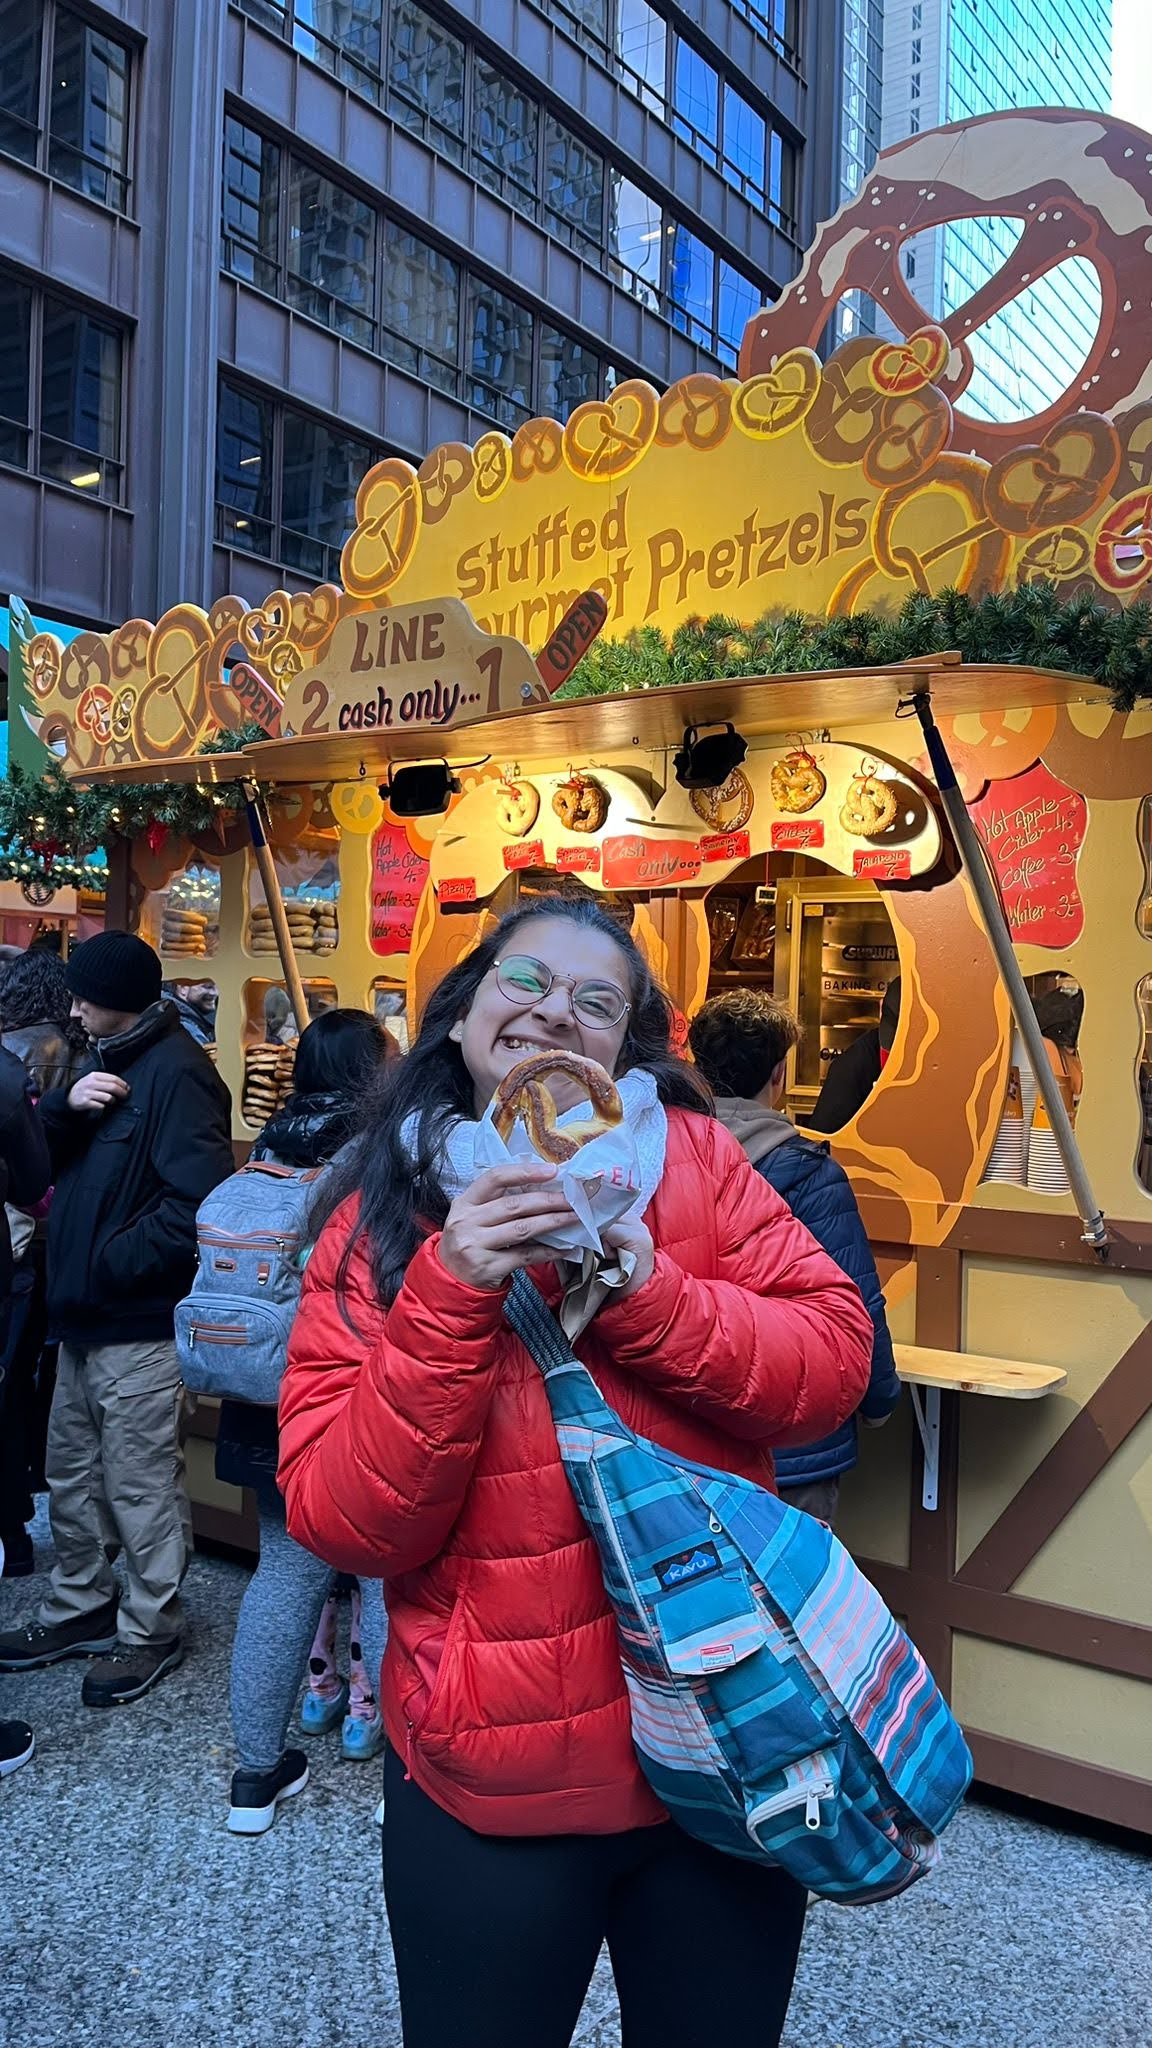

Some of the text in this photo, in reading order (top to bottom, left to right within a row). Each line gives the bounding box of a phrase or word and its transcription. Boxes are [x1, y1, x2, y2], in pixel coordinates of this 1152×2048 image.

[456, 487, 631, 600] Stuffed
[642, 489, 872, 622] Pretzels
[546, 592, 605, 671] OPEN
[475, 646, 504, 714] 1
[230, 667, 280, 728] OPEN
[302, 680, 330, 735] 2
[338, 685, 393, 730] cash
[982, 808, 1012, 844] Hot
[1015, 798, 1060, 832] Apple
[376, 834, 393, 857] Hot
[604, 838, 646, 861] Cash
[998, 826, 1046, 862] Cider
[376, 853, 401, 876] Apple
[1001, 856, 1046, 890] Coffee
[374, 890, 398, 915] Coffee
[439, 881, 465, 897] PIZZA
[1008, 894, 1046, 928] Water
[845, 946, 899, 960] SUBWA
[824, 980, 872, 991] BAKING
[669, 1558, 708, 1580] KAVU
